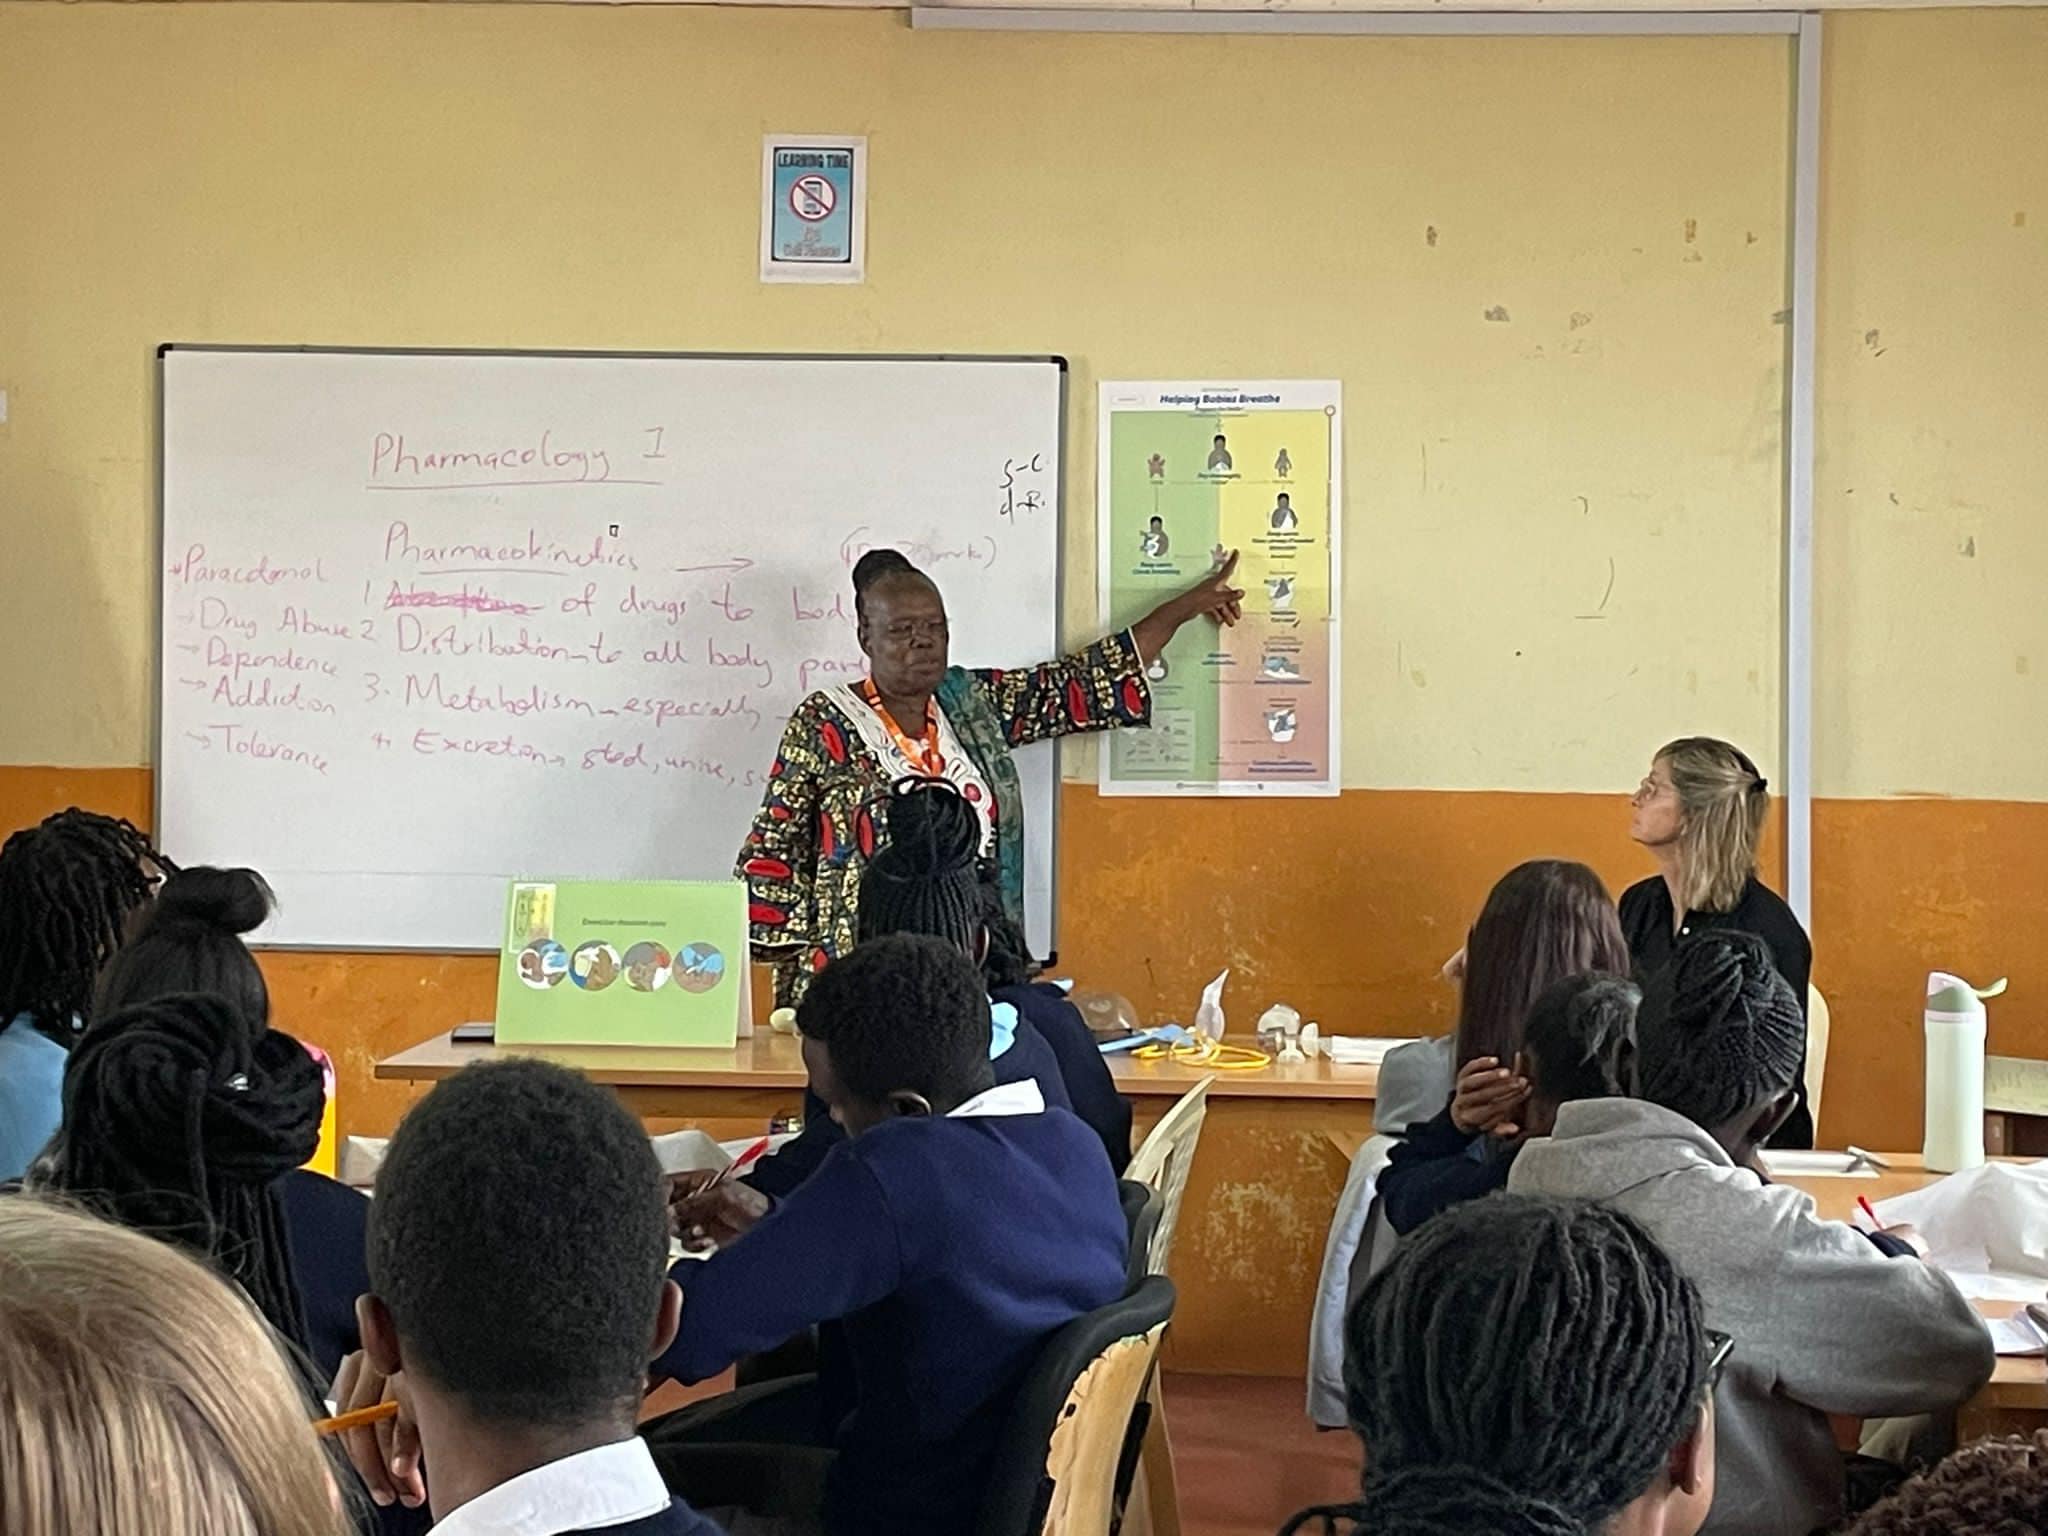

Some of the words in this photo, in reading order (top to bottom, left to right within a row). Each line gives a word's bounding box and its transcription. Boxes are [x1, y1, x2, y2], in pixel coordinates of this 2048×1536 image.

[1160, 395, 1200, 406] Helping
[372, 429, 610, 482] Pharmacology
[200, 596, 257, 640] Drug
[561, 582, 597, 616] of
[619, 584, 688, 626] drugs
[711, 582, 754, 621] to
[207, 635, 338, 680] Dependence
[642, 640, 690, 665] all
[708, 637, 773, 688] body
[212, 674, 336, 715] Addiction
[208, 723, 328, 777] Tolerance
